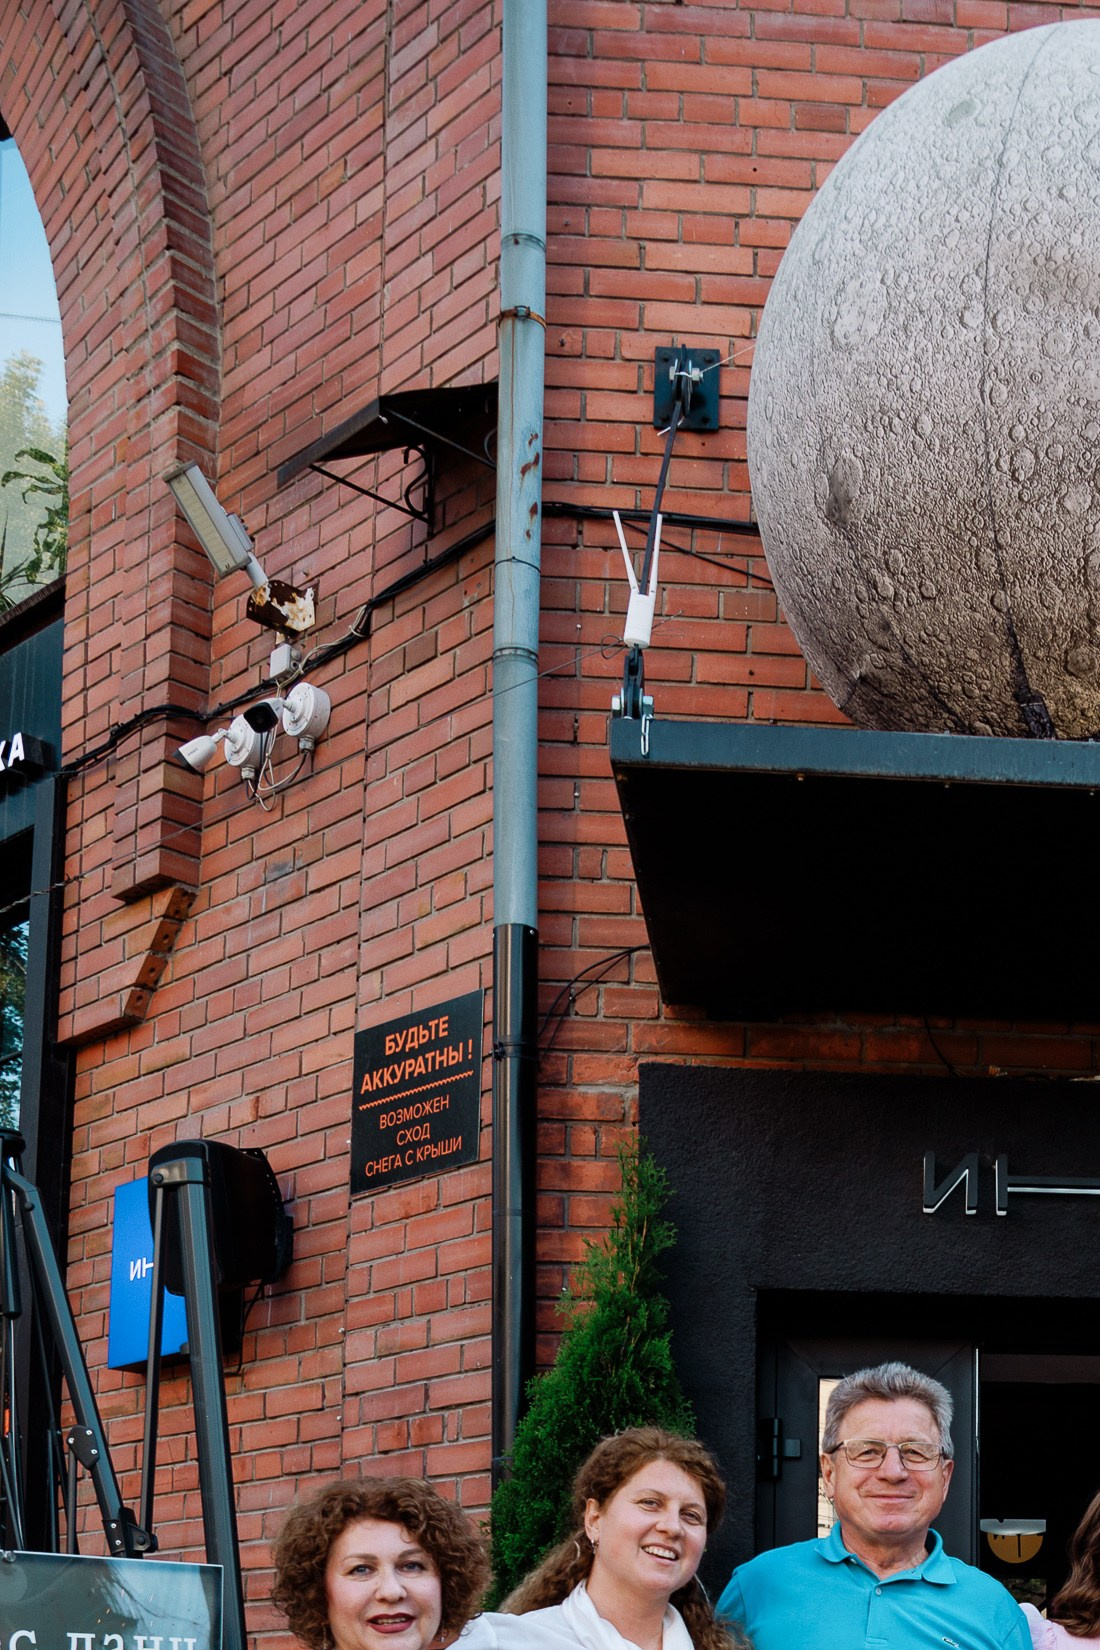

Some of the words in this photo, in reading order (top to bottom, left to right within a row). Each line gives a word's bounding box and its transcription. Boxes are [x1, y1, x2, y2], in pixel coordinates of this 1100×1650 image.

[385, 1015, 449, 1056] БУДЬТЕ
[379, 1094, 449, 1130] ВОЗМОЖЕН
[396, 1122, 431, 1146] СХОД
[365, 1153, 403, 1177] СНЕГА
[405, 1149, 414, 1165] С
[416, 1135, 462, 1162] КРЫШИ
